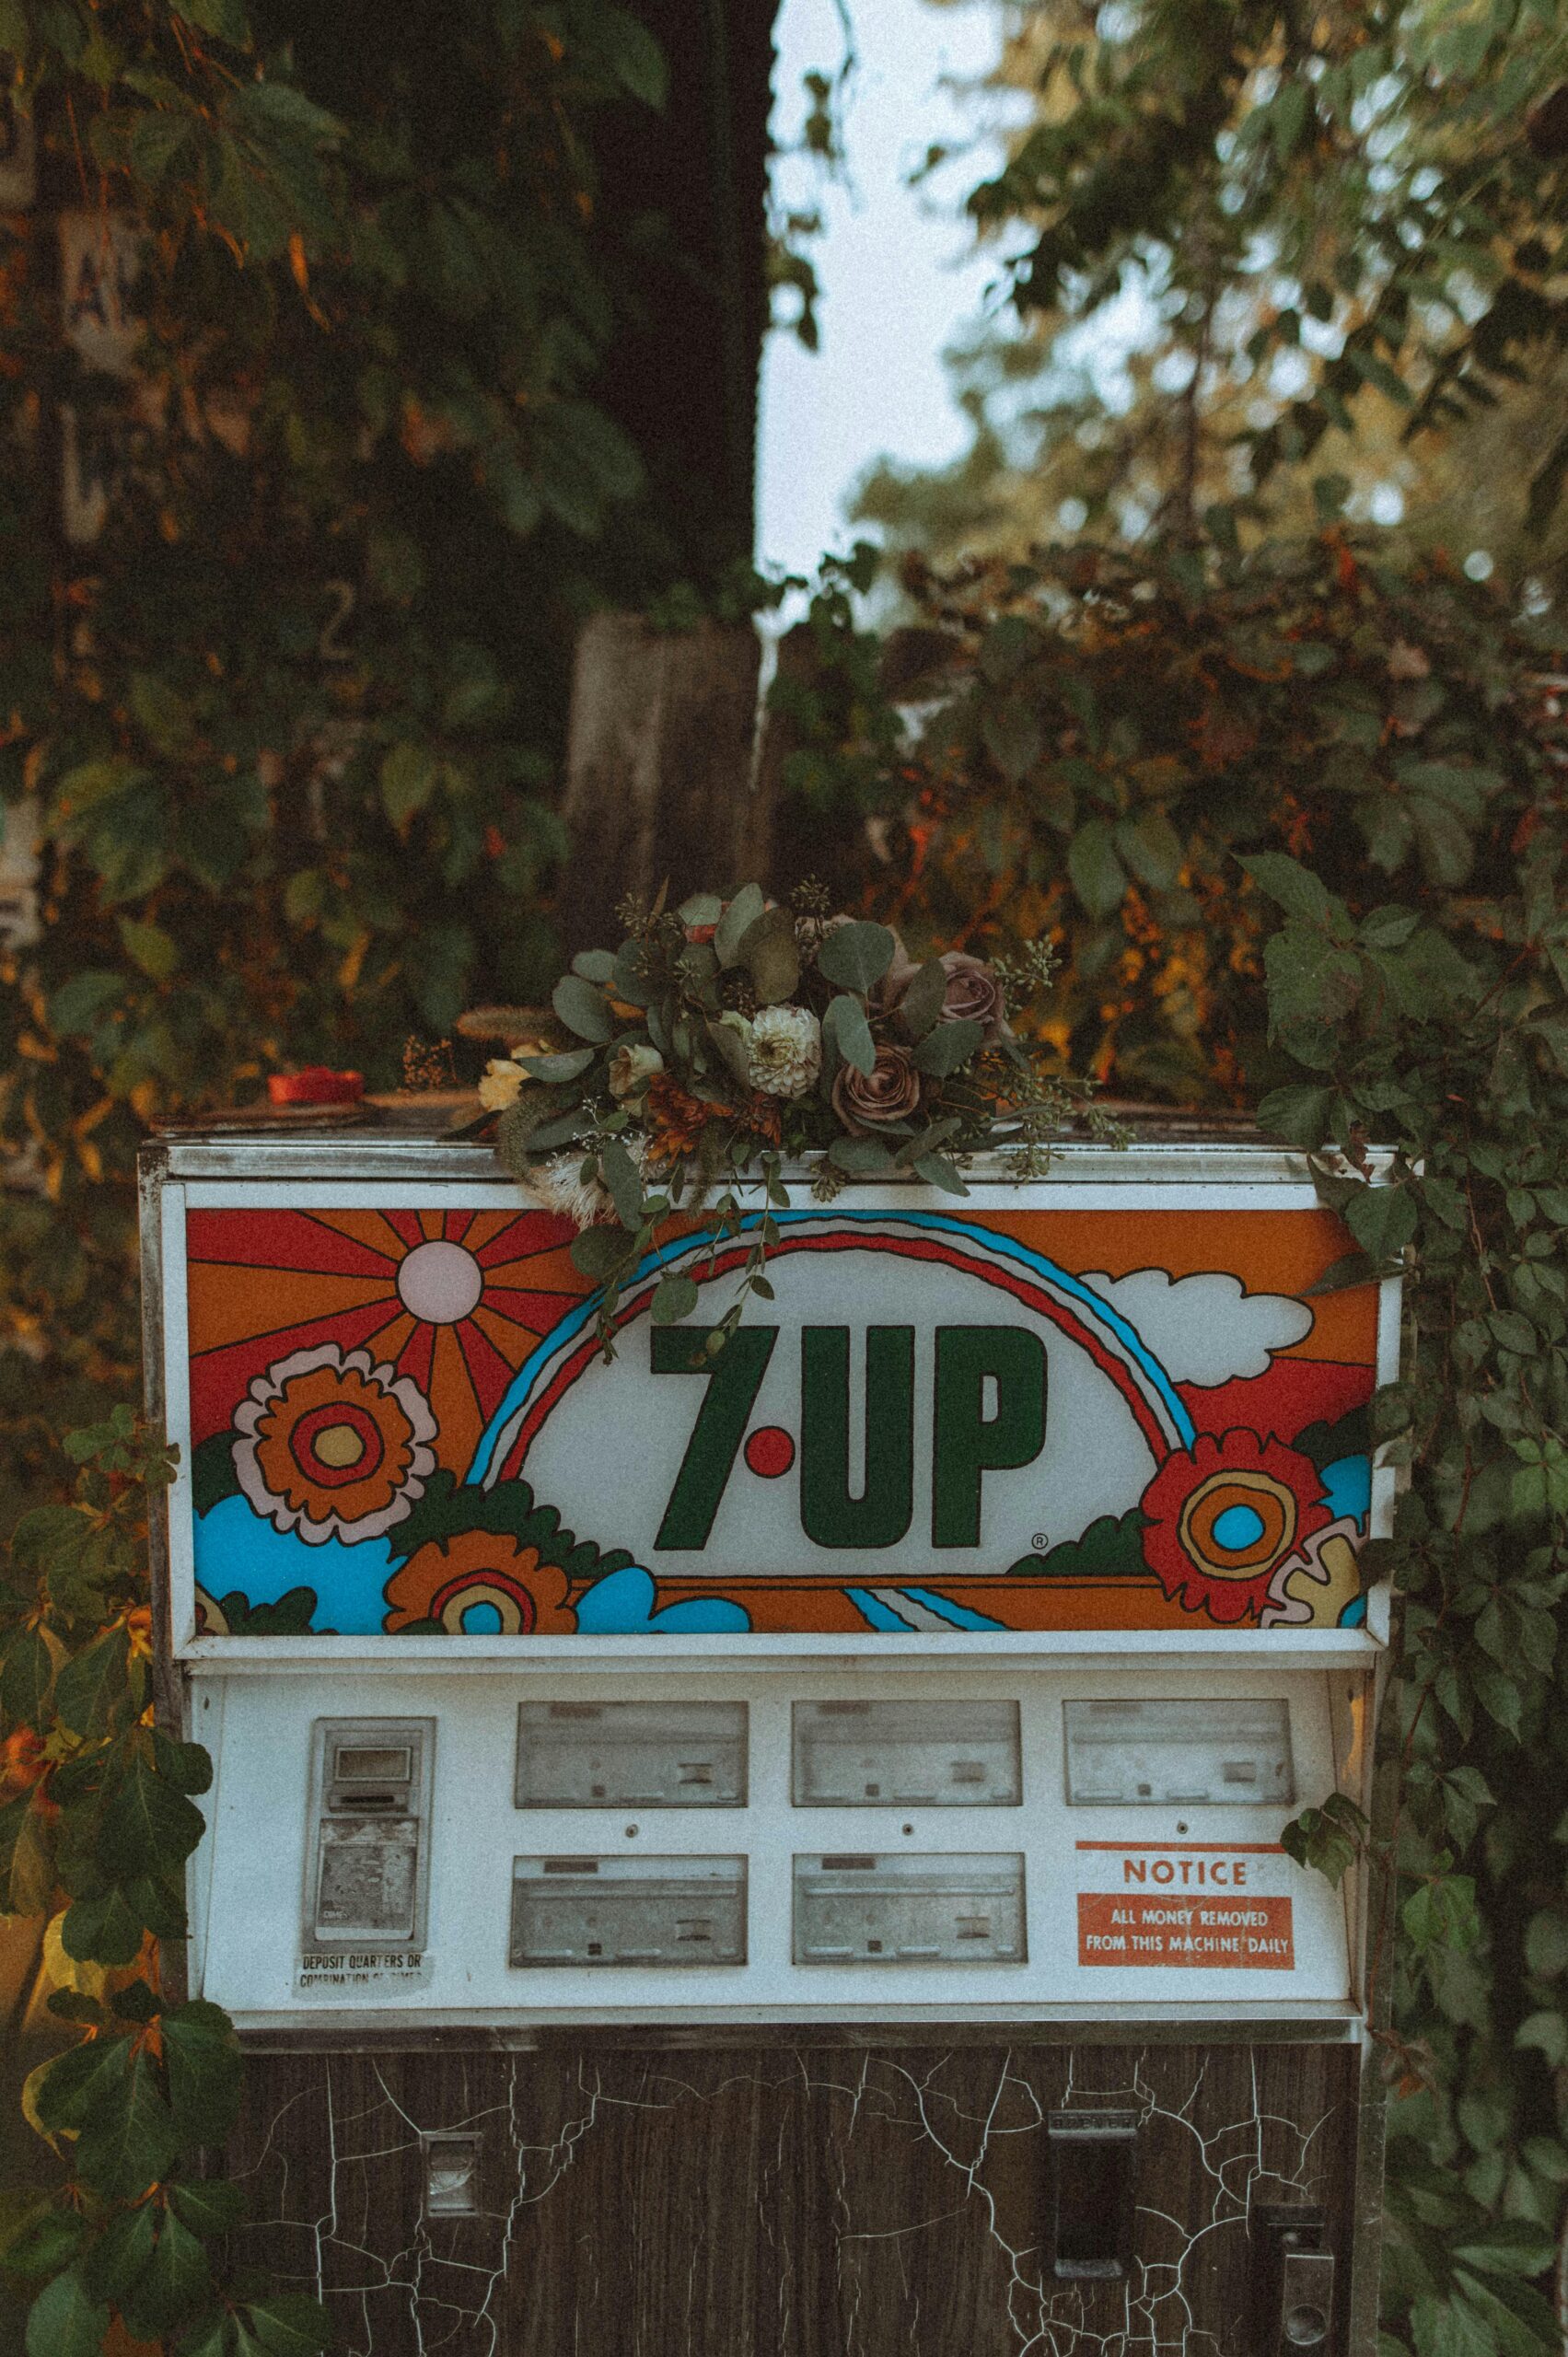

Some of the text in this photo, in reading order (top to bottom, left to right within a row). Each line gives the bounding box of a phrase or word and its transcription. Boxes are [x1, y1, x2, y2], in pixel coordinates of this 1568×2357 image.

[1123, 1859, 1248, 1886] NOTICE
[1110, 1909, 1269, 1927] ALL MONEY REMOVED
[1086, 1934, 1289, 1954] FROM THIS MACHINE DAILY
[302, 1953, 422, 1970] DEPOSIT QUARTERS OR
